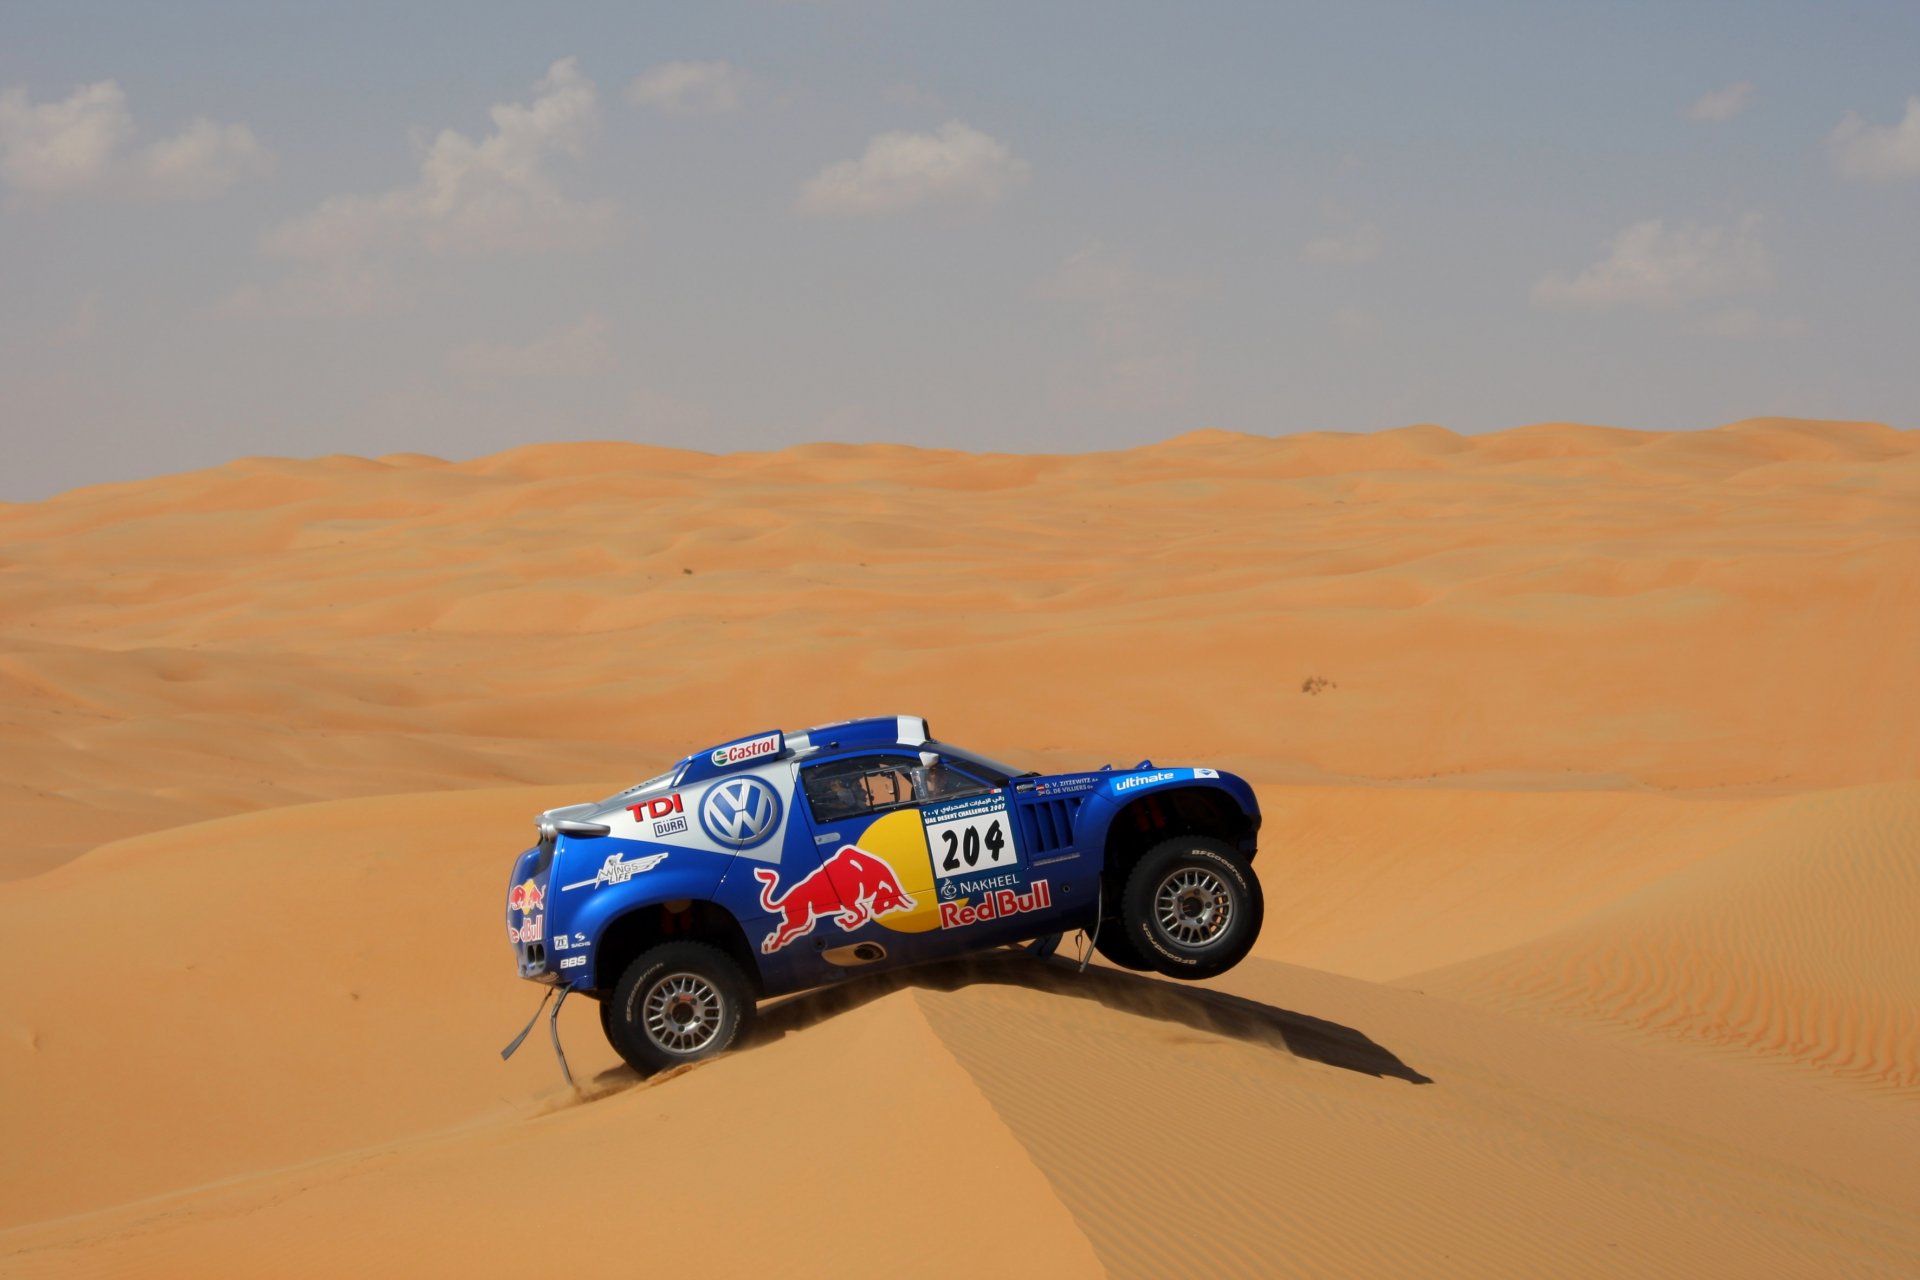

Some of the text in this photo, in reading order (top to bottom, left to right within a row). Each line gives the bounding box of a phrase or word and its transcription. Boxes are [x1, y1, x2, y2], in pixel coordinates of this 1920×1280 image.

[729, 739, 775, 762] Castrol
[1061, 784, 1087, 793] VILLIERS
[1116, 772, 1174, 791] ultimate
[625, 793, 684, 822] TDI
[924, 803, 1006, 824] UAE DESERT CHALLENGE 2007
[657, 819, 685, 835] DÜRR
[942, 819, 1005, 871] 204
[599, 863, 638, 878] WINGS
[960, 873, 1020, 894] NAKHEEL
[939, 879, 1052, 930] Red Bull
[560, 955, 587, 969] BBS
